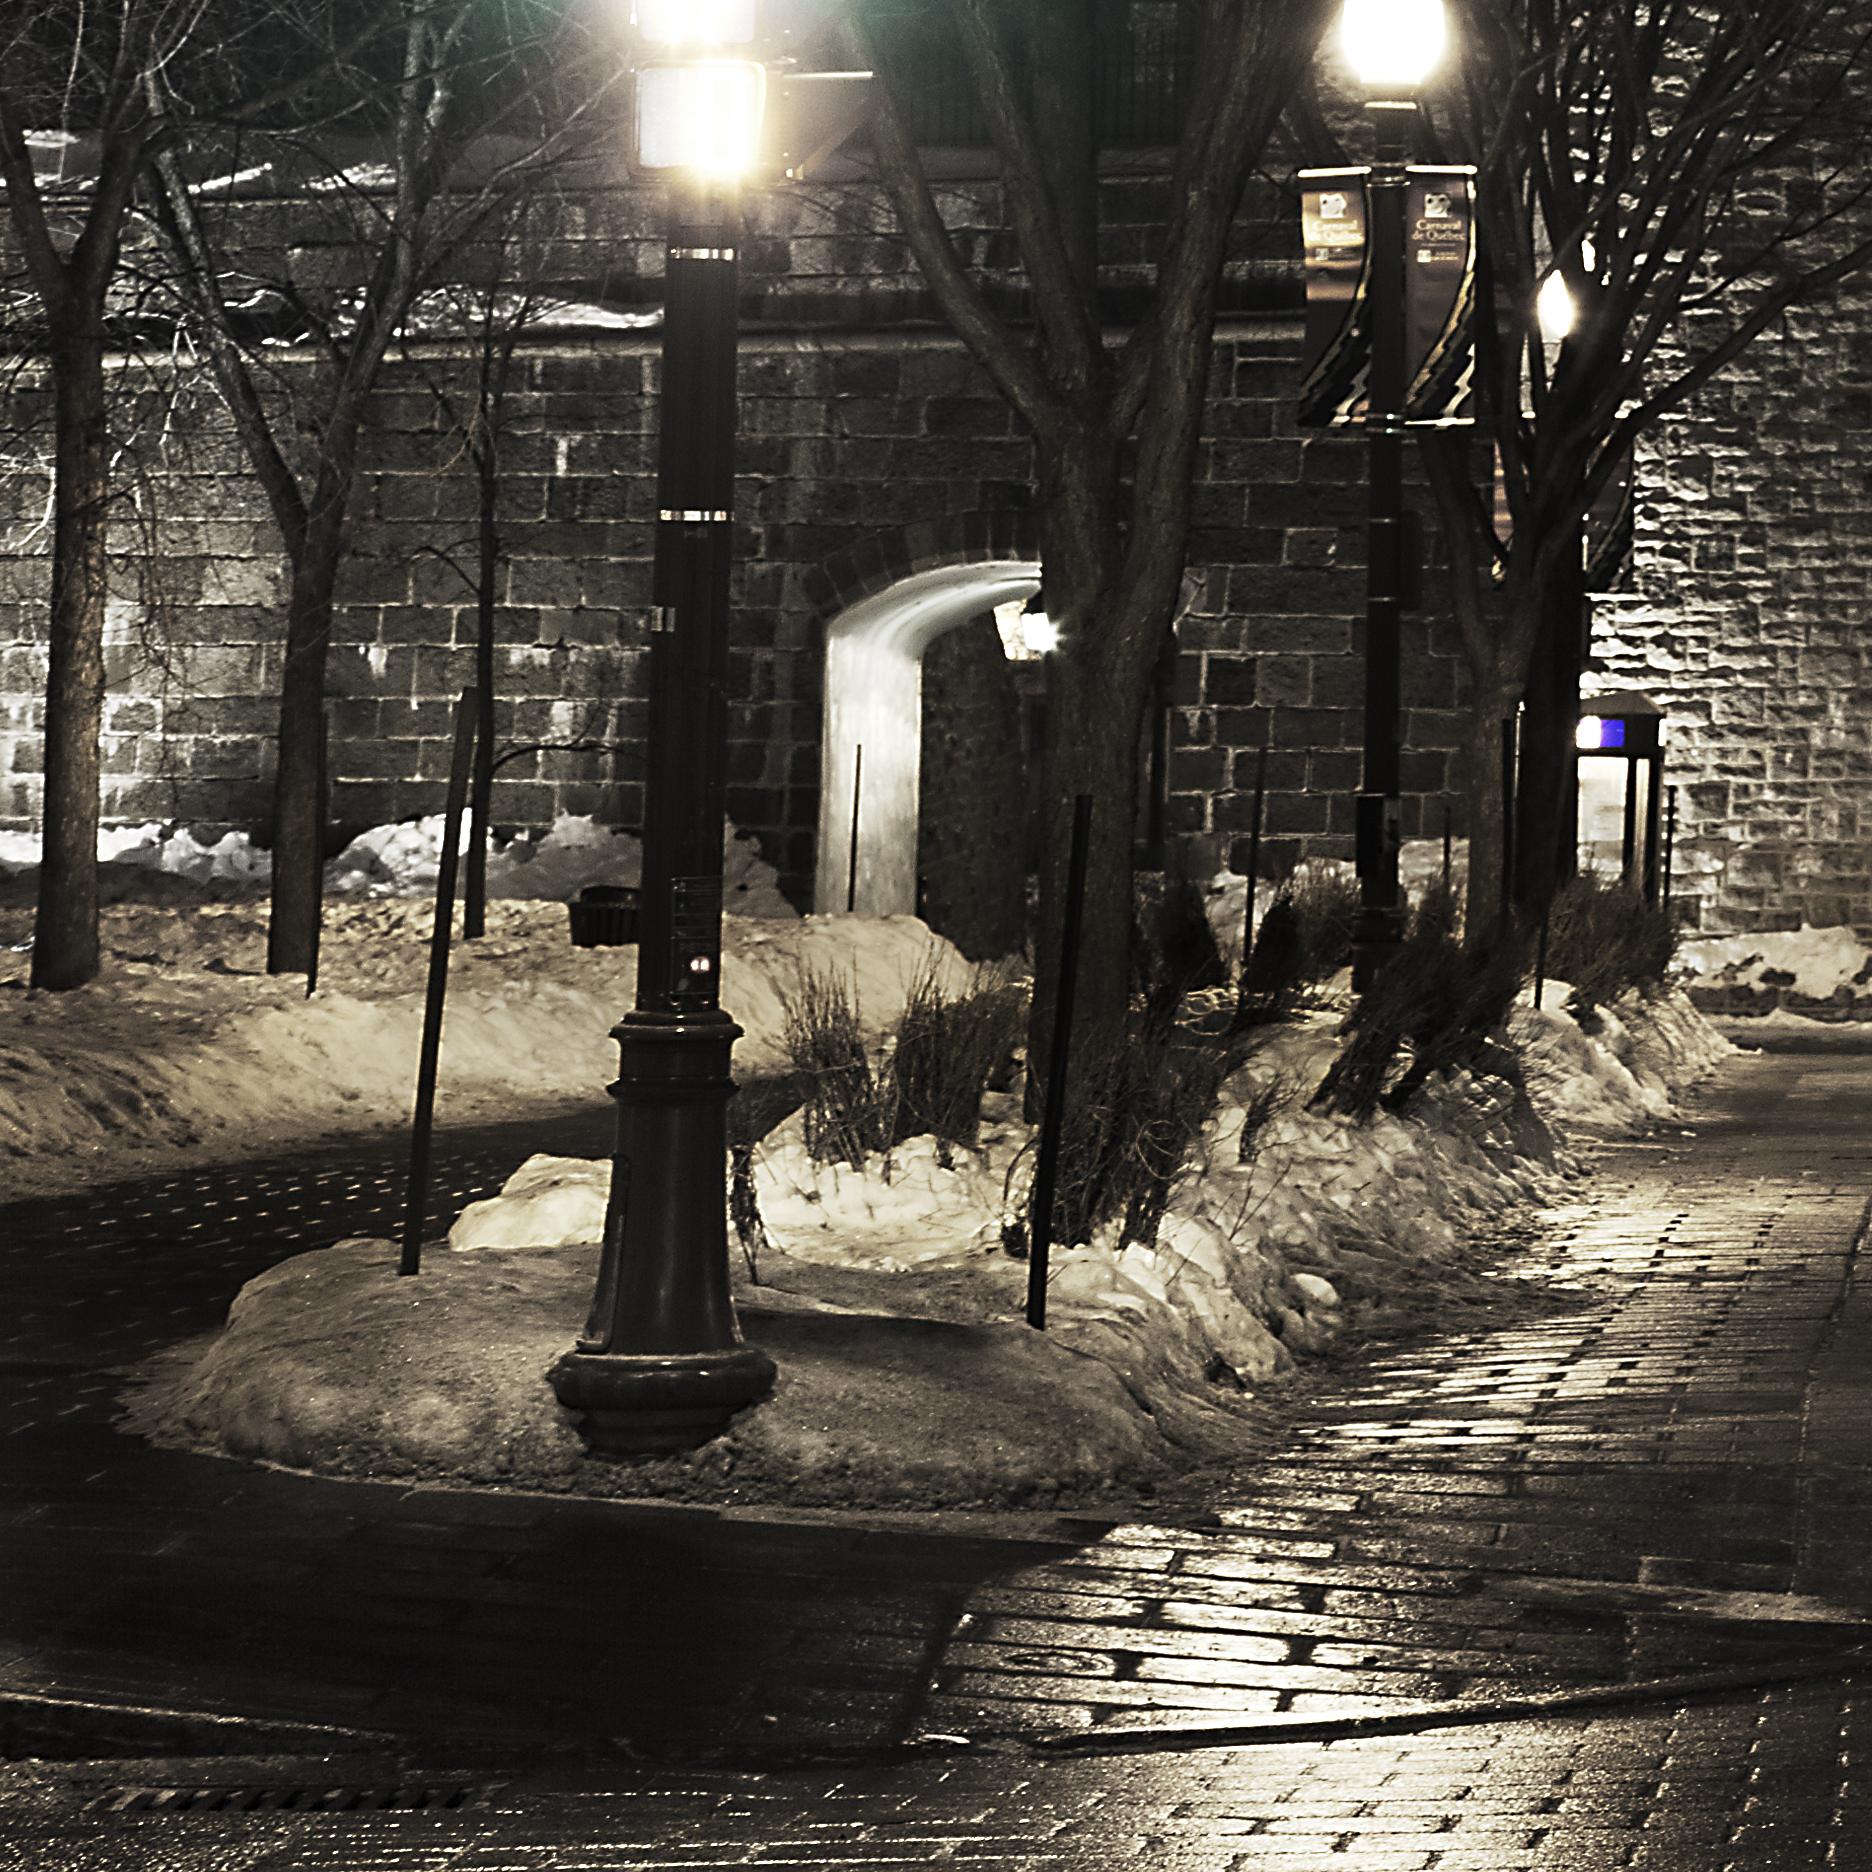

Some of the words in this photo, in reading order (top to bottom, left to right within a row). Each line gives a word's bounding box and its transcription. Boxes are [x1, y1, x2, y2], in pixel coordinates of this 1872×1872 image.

[1416, 220, 1462, 230] Carnaval
[1411, 230, 1423, 240] de
[1426, 230, 1465, 241] Québec
